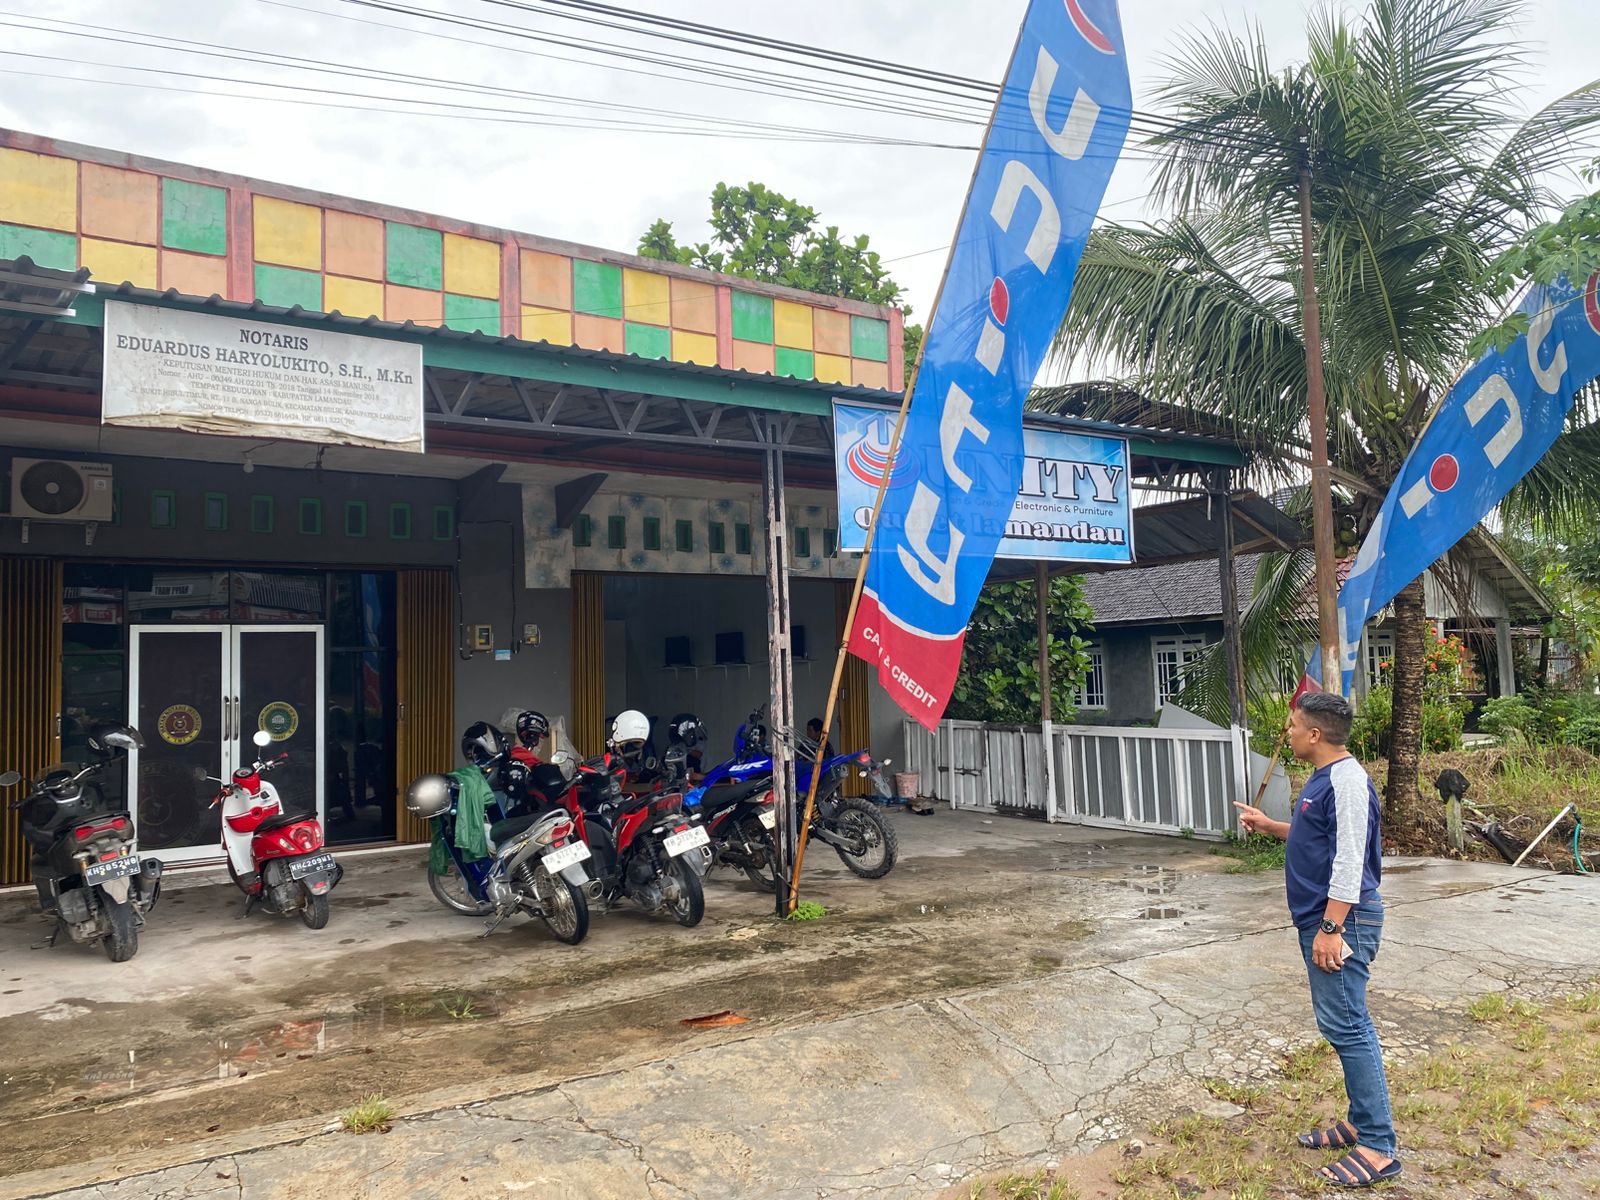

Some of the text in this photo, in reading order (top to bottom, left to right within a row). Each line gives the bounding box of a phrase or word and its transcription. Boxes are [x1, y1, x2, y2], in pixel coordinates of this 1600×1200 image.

[240, 329, 309, 351] NOTARIS
[116, 334, 413, 385] EDUARDUS HARYOLUKITO, S.H., M.Kn
[163, 359, 375, 392] KEPUTUSAN MENTERI HUKUM DAN HAK ASASI MANUSIA
[1015, 500, 1062, 514] Electronic
[1064, 505, 1071, 514] &
[1074, 505, 1114, 517] Purniture
[862, 627, 938, 708] CA & CREDIT
